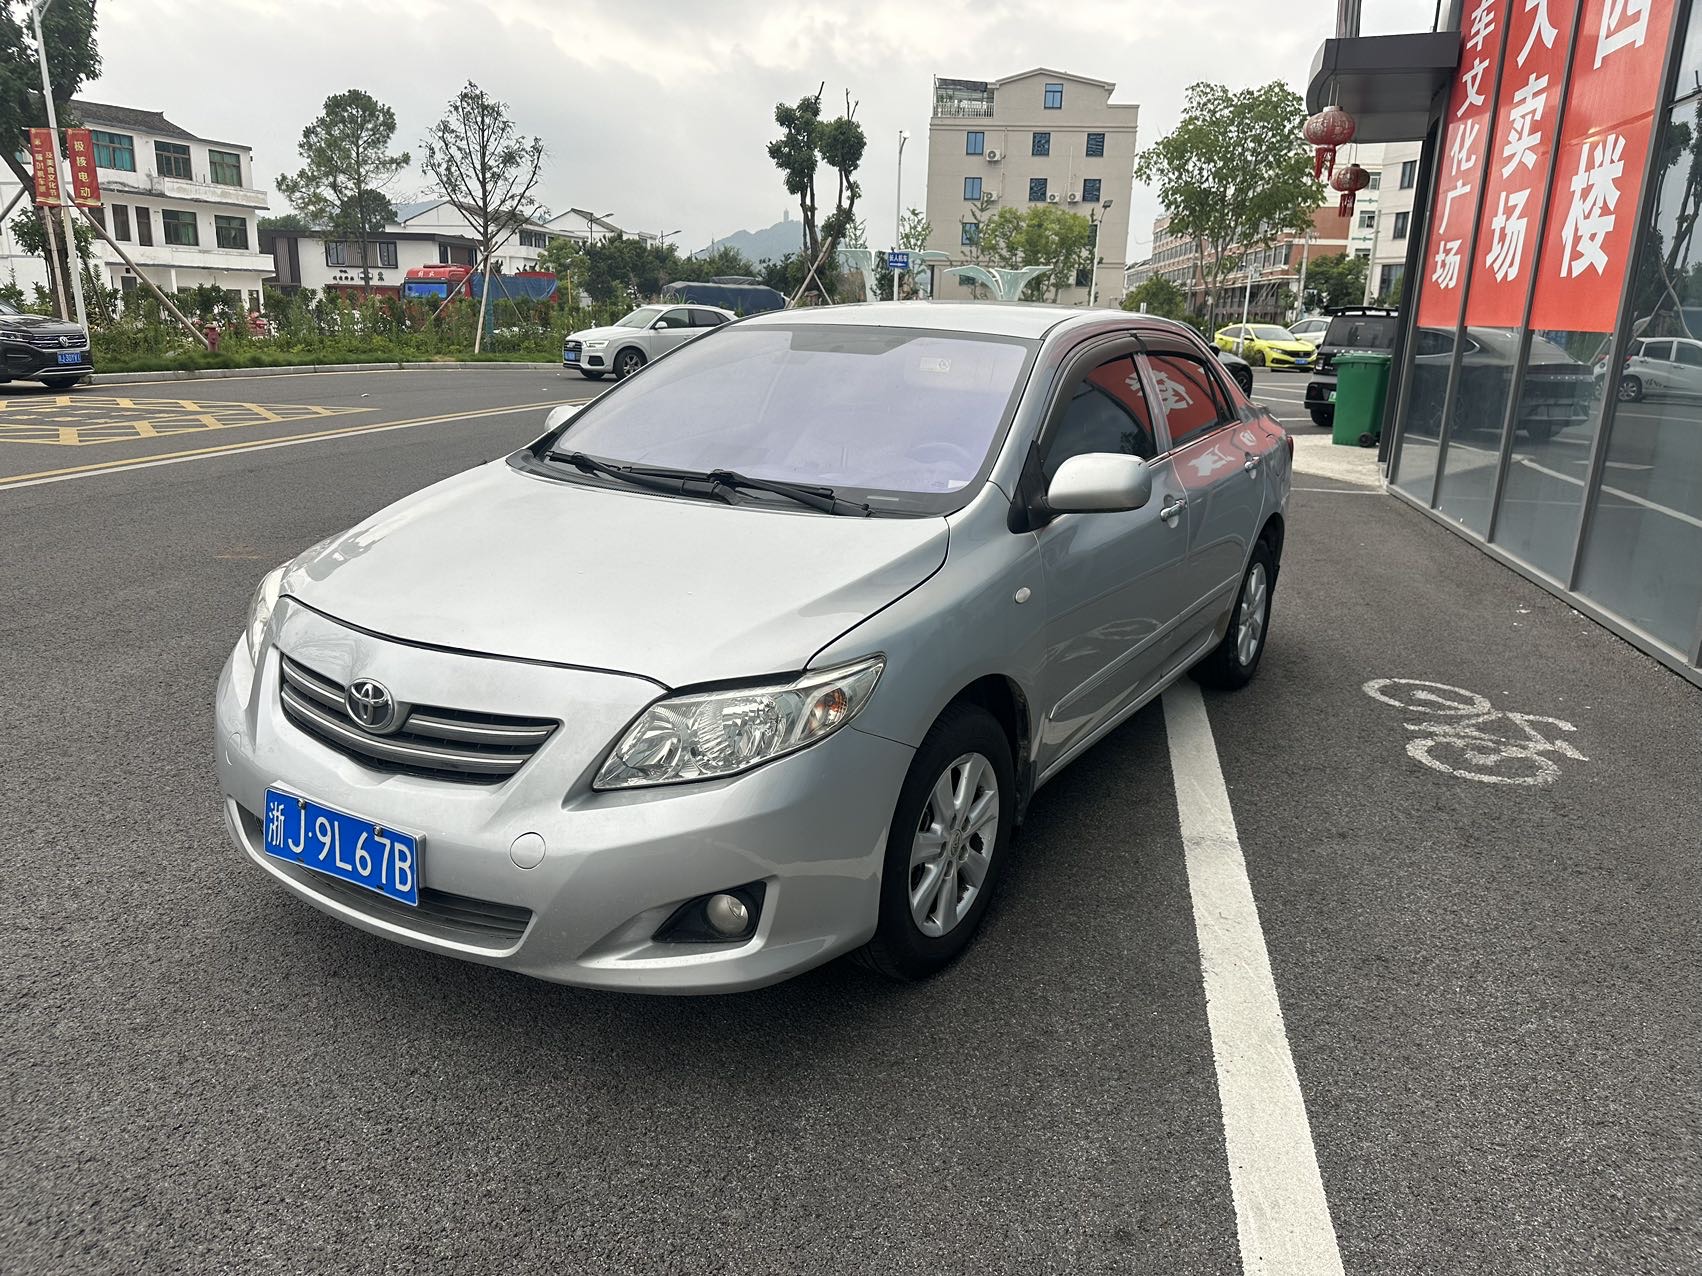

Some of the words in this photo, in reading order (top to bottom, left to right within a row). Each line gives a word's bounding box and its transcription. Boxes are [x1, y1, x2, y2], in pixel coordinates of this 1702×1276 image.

[74, 140, 91, 197] 极核电动
[1432, 0, 1494, 289] 车文化广场
[1485, 0, 1558, 283] 大卖场
[1559, 0, 1652, 278] 四楼
